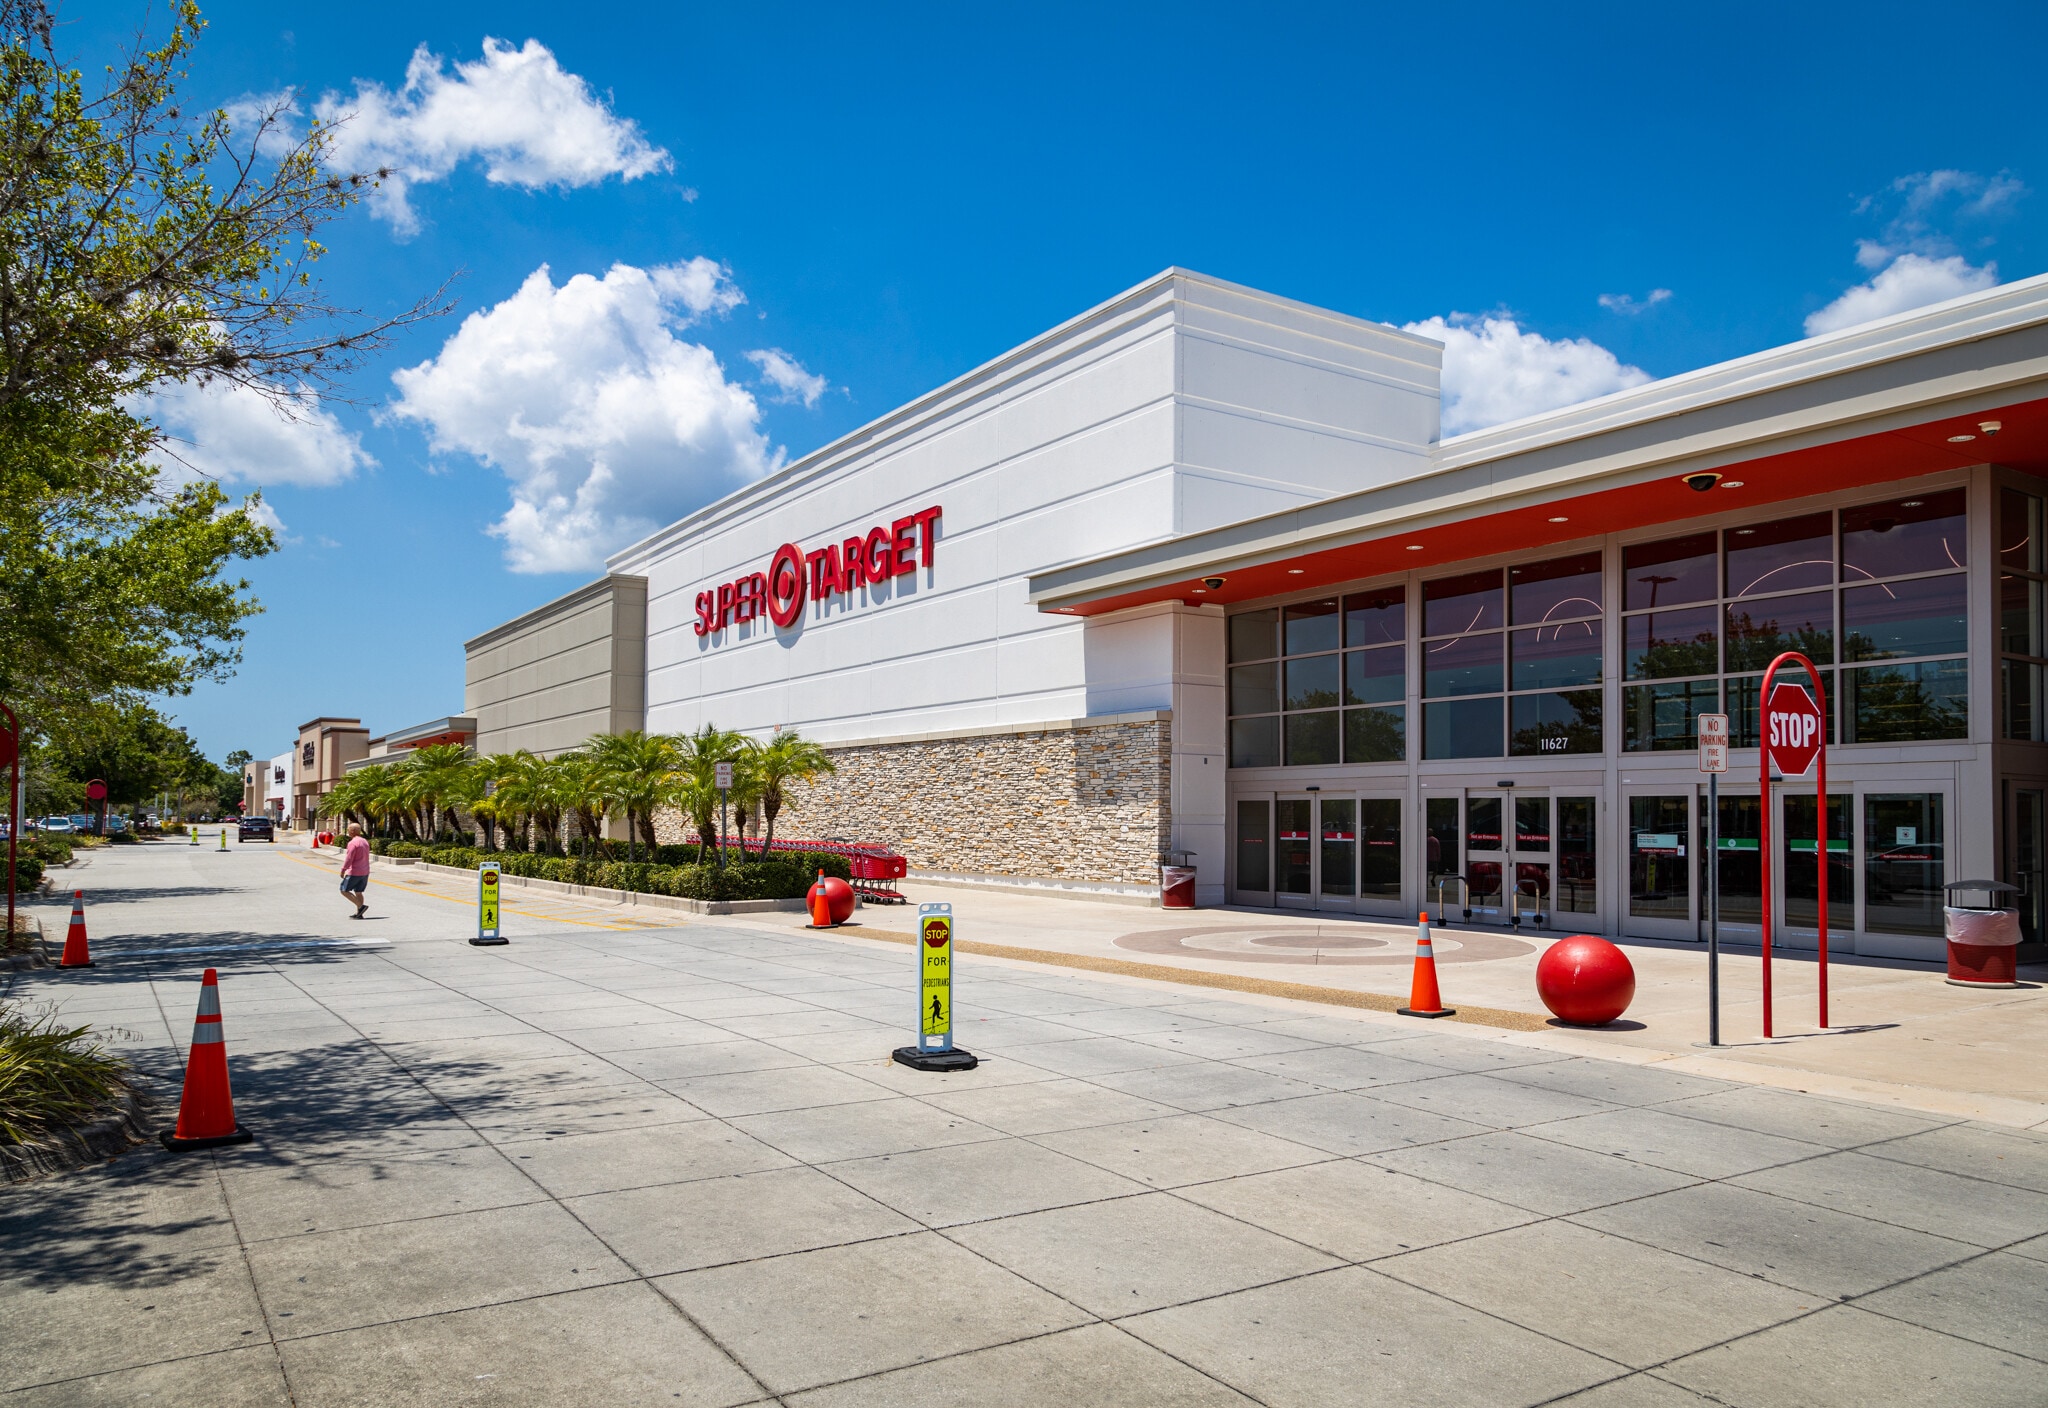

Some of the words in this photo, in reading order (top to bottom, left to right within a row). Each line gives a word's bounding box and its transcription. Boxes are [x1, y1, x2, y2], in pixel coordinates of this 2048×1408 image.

[694, 572, 767, 636] SUPER
[806, 505, 942, 602] TARGET
[1707, 720, 1719, 732] NO
[1769, 711, 1816, 748] STOP
[1541, 737, 1569, 751] 11627
[1700, 734, 1726, 746] PARKING
[1707, 748, 1719, 757] FIRE
[1706, 759, 1720, 768] LANE
[925, 929, 948, 940] STOP
[927, 956, 947, 967] FOR
[924, 978, 950, 988] PEDESTRIANS
